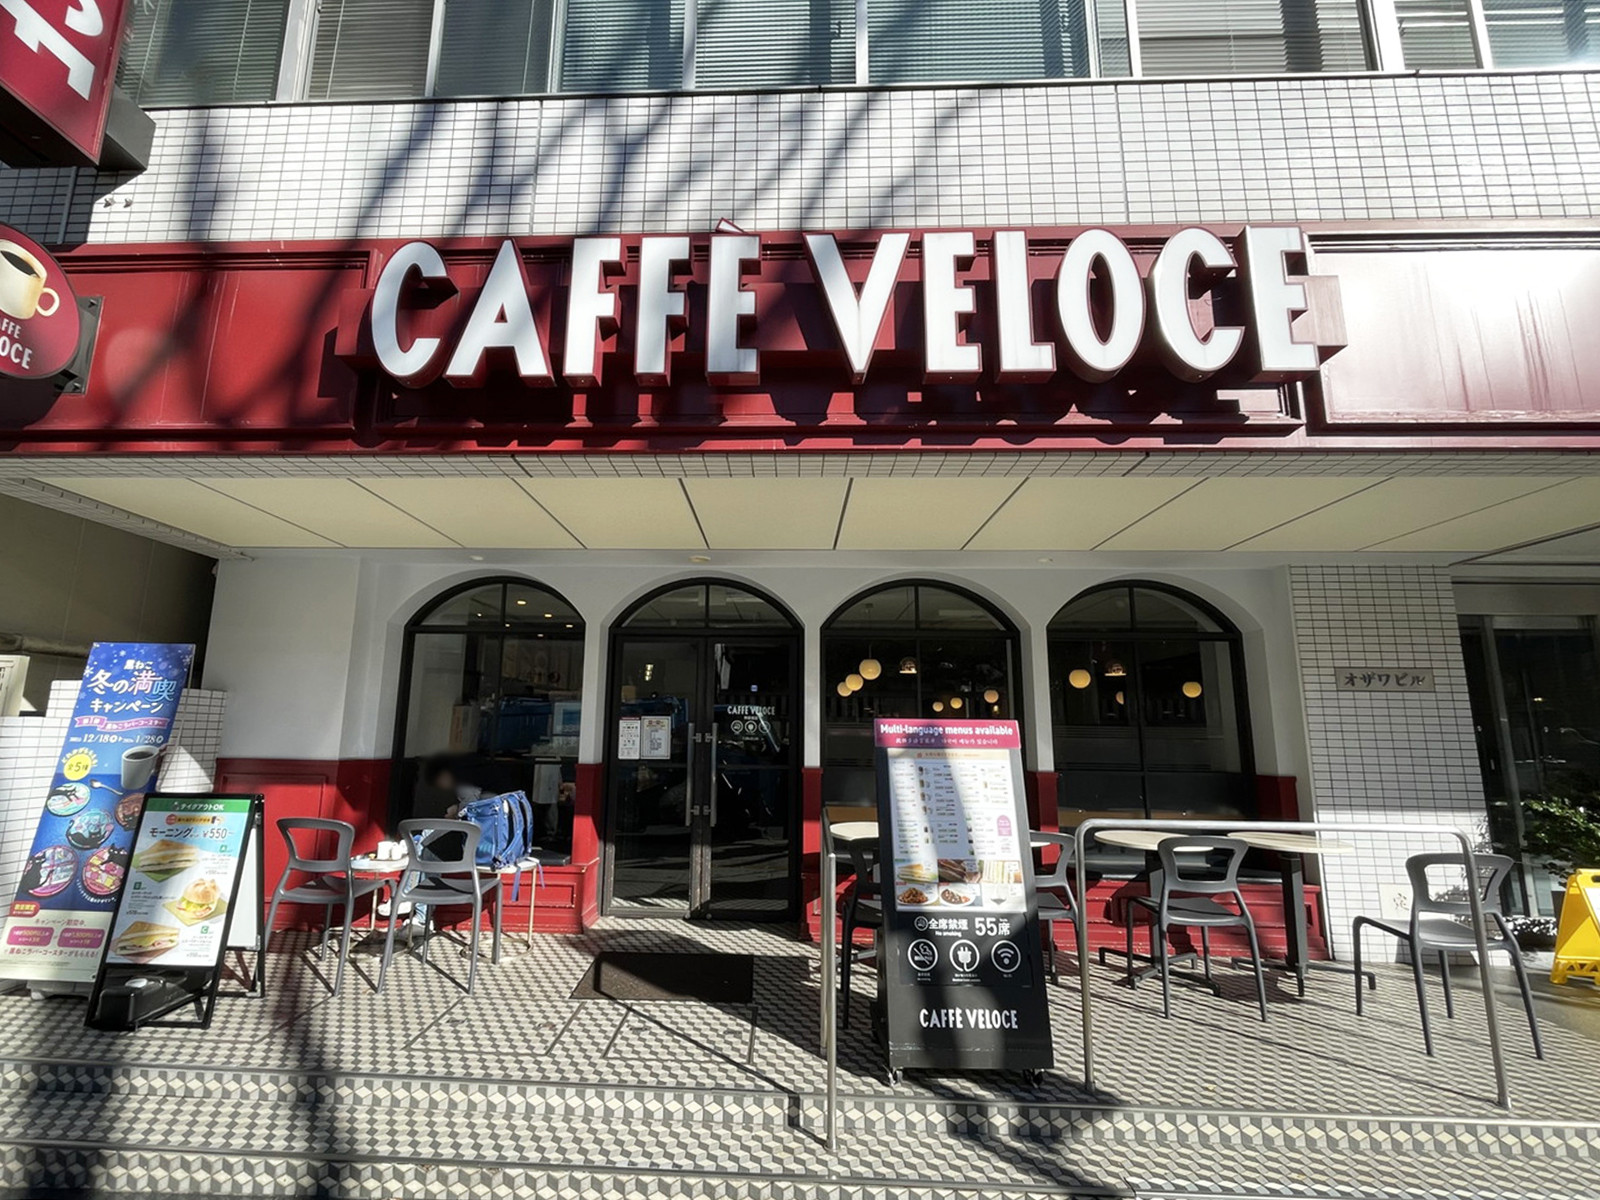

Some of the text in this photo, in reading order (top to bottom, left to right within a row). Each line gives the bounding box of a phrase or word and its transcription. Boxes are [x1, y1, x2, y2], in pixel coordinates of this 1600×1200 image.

[370, 217, 1321, 380] CAFFÈ VELOCE
[123, 659, 154, 670] 黒ねこ
[87, 669, 177, 702] 冬の満喫
[1344, 672, 1426, 687] オザワビル
[90, 698, 164, 713] キャンペーン
[880, 724, 1013, 737] Multi-language menus available
[180, 803, 225, 811] テイクアウトOK
[928, 918, 969, 930] 全席禁煙
[966, 1009, 1019, 1030] VELOCE
